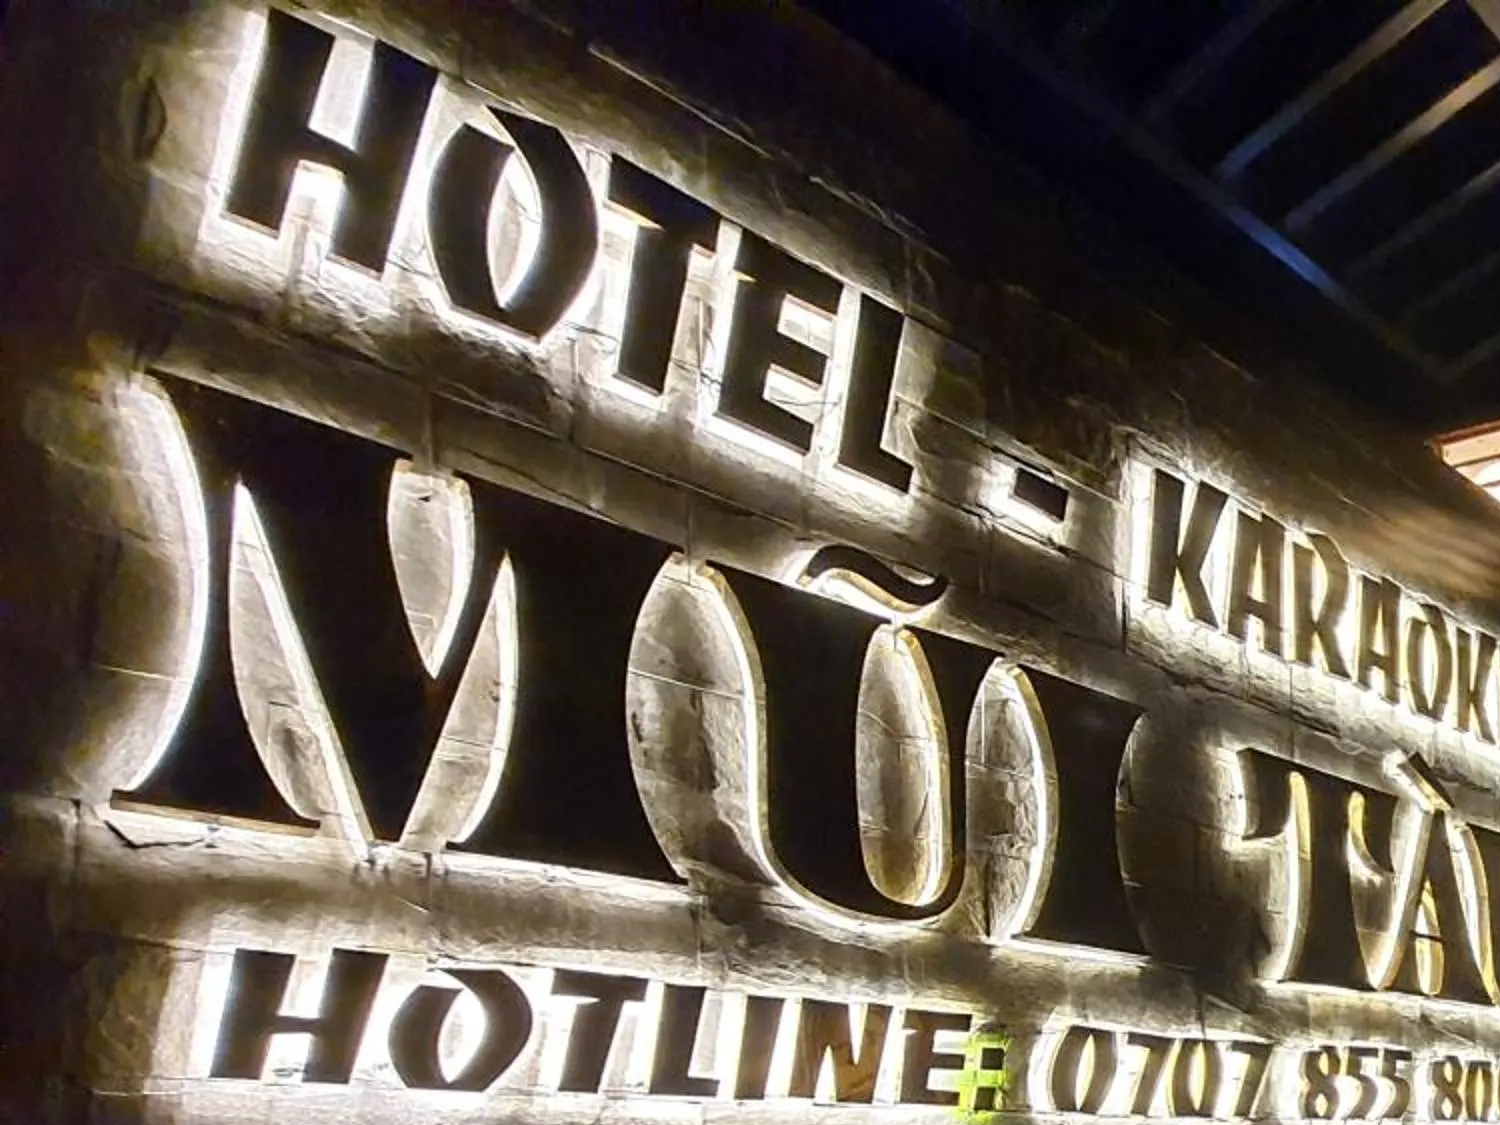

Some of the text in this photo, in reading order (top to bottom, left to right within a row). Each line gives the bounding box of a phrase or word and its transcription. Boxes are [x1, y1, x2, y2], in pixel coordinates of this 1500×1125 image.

[220, 8, 914, 495] HOTEL
[108, 367, 1152, 957] MŨI
[208, 947, 1005, 1111] HOTLINE:
[1050, 1025, 1275, 1118] 0707
[1299, 1044, 1413, 1120] 855
